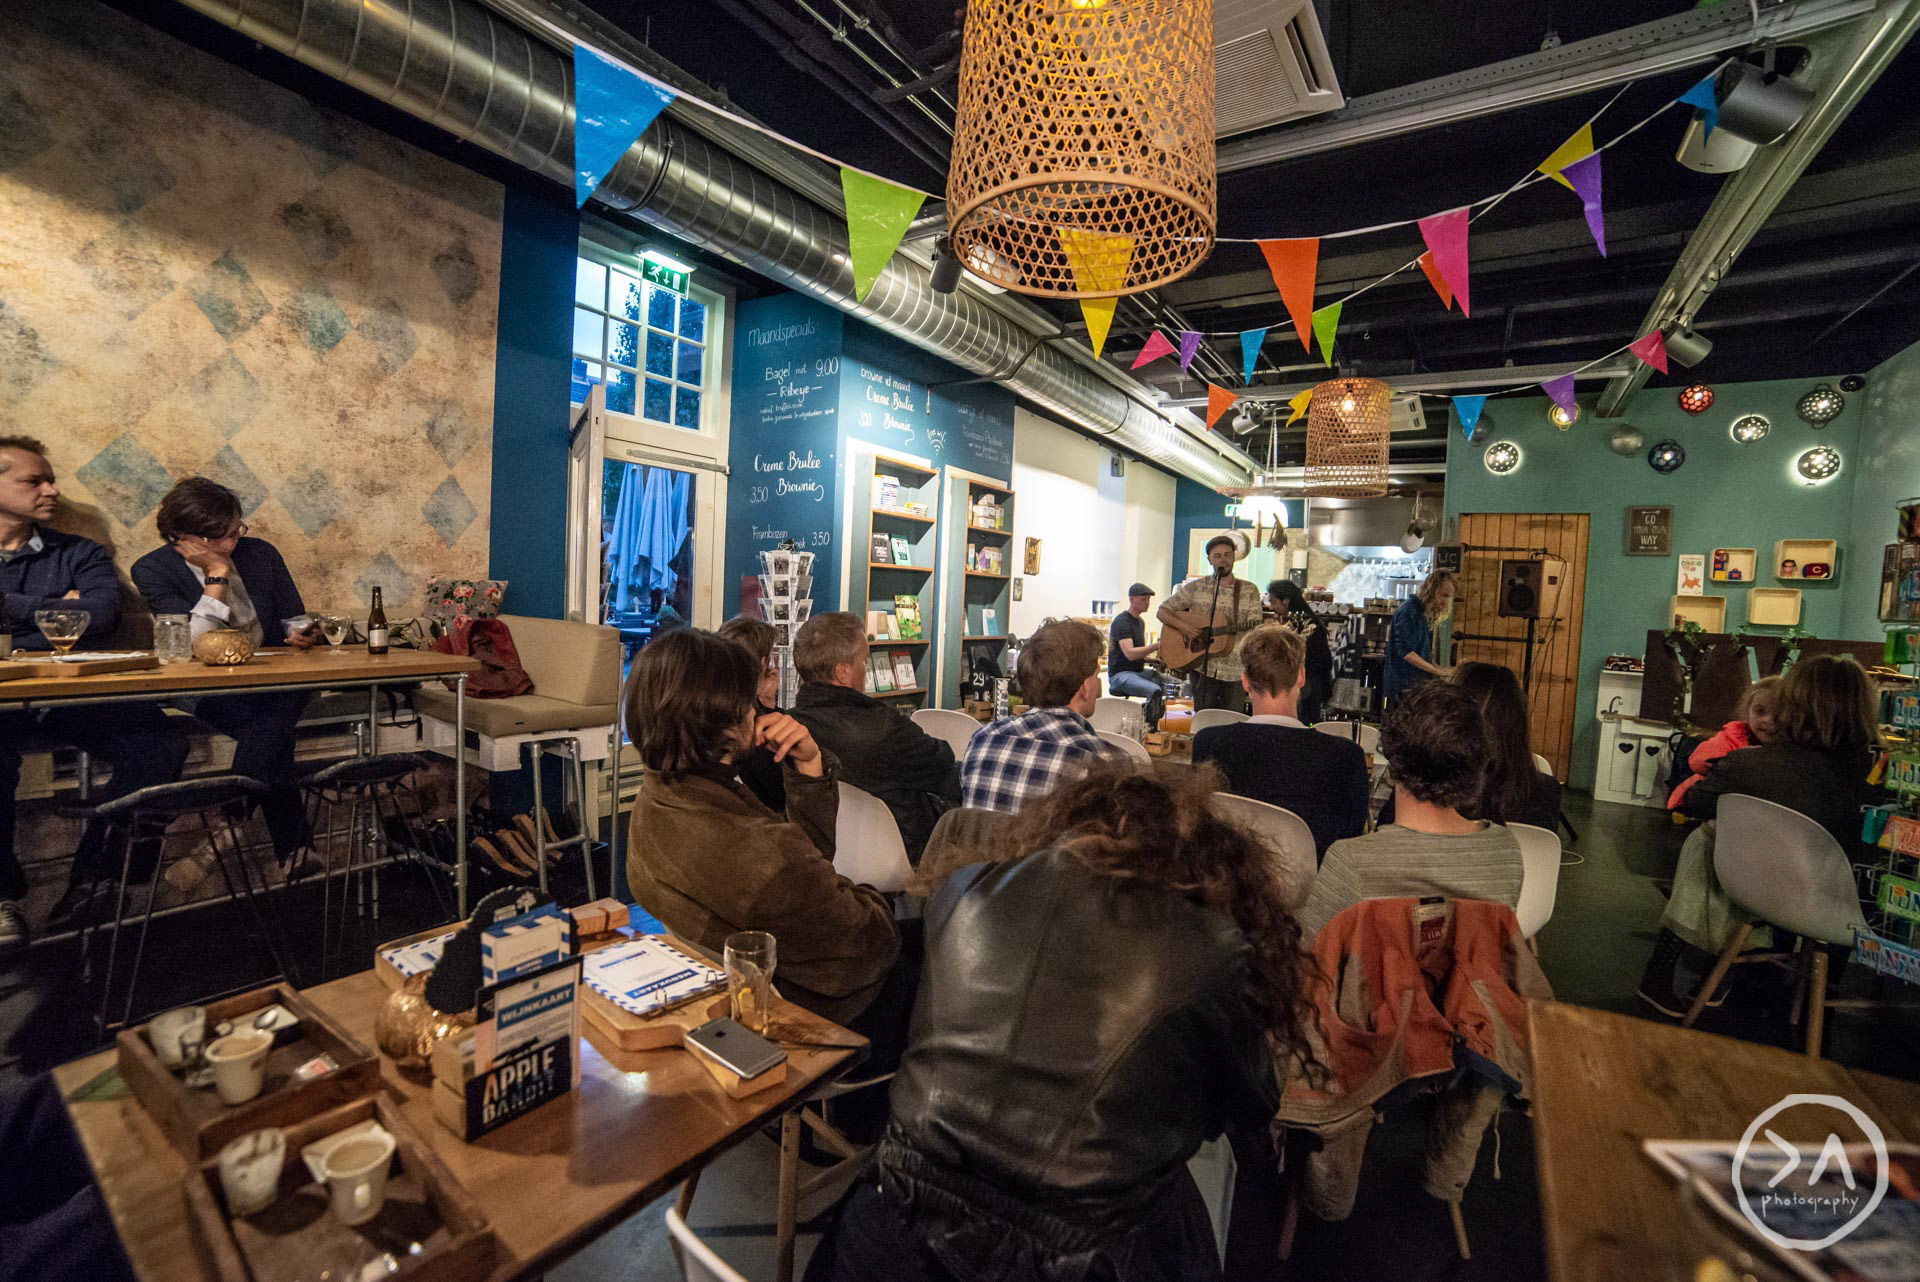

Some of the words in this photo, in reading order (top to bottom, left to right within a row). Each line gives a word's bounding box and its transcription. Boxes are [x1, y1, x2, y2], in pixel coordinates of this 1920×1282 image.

[765, 361, 791, 385] Bagel
[816, 357, 839, 377] 9.00
[779, 382, 810, 402] Ribeye
[776, 478, 824, 502] Brownie
[1645, 514, 1656, 525] GO
[1640, 535, 1658, 545] WAY
[973, 672, 985, 687] 29
[501, 988, 572, 1024] WIJNKAART
[483, 1045, 556, 1101] APPLE
